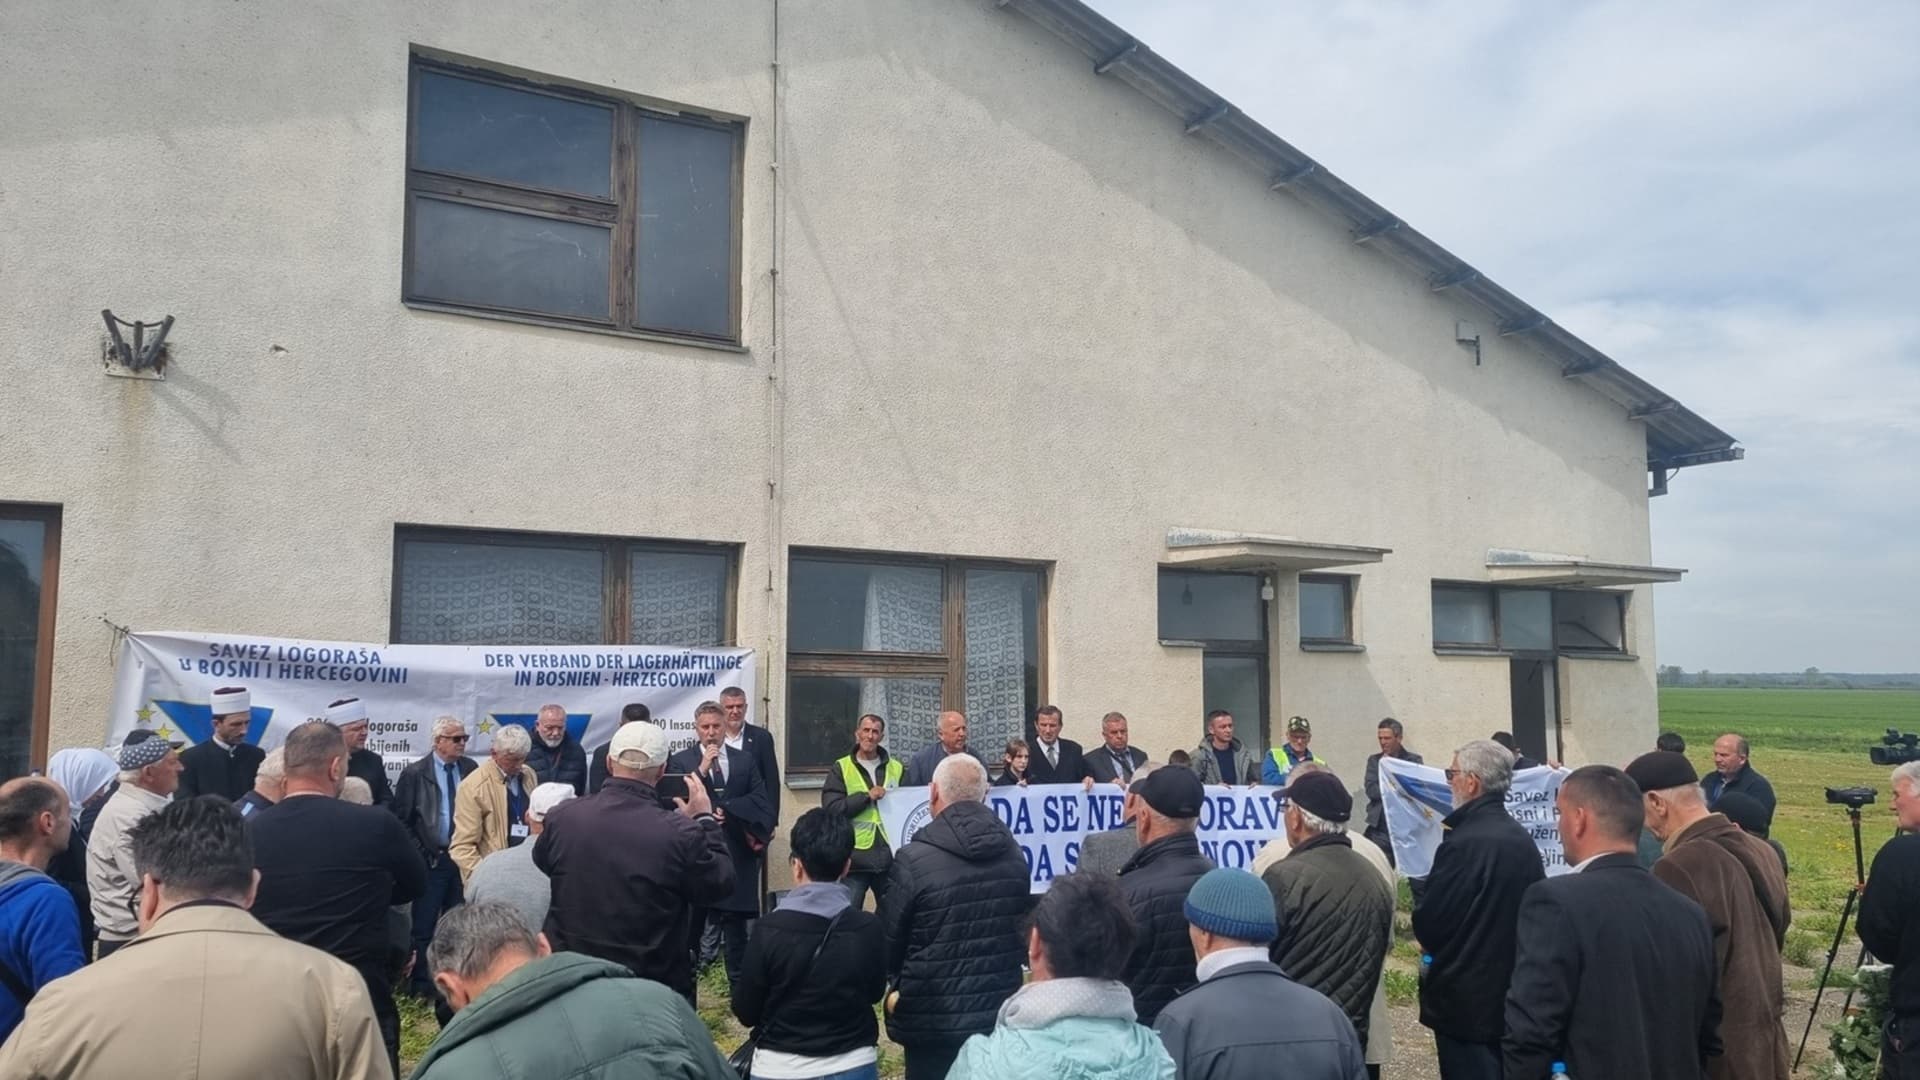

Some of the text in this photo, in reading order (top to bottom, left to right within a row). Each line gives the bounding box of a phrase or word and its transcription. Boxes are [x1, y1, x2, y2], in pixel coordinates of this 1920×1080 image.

[209, 643, 382, 665] SAVEZ LOGORAŠA
[484, 650, 743, 671] DER VERBAND DER LAGERHÄFTLINGE
[198, 659, 259, 678] BOSNI
[266, 663, 272, 679] I
[279, 663, 409, 684] HERCEGOVINI
[514, 670, 531, 687] IN
[536, 670, 600, 687] BOSNIEN
[612, 671, 717, 688] HERZEGOWINA
[1504, 789, 1550, 803] Savez
[1043, 795, 1080, 833] SE
[1087, 794, 1125, 831] NE
